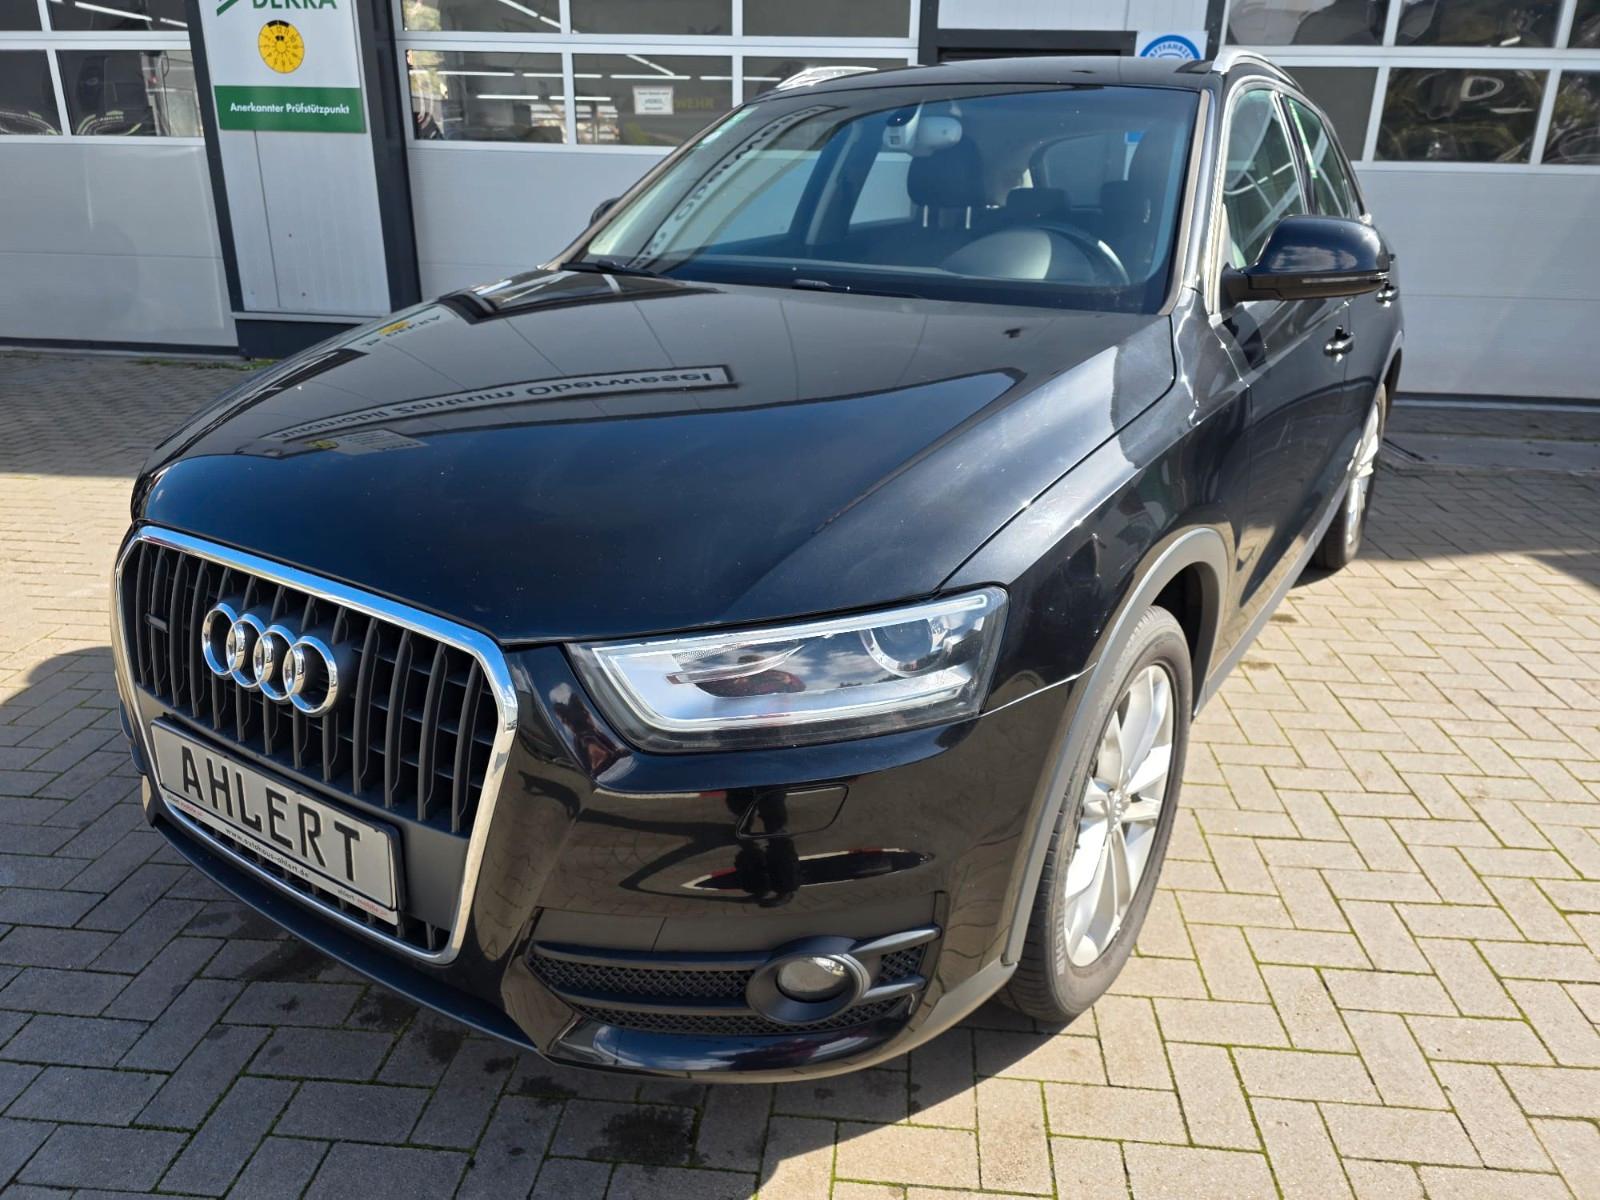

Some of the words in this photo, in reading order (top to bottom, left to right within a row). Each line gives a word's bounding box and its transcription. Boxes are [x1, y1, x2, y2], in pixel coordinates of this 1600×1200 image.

[230, 101, 284, 113] Anerkannter
[285, 102, 350, 116] Prüfstützpunkt
[181, 745, 361, 882] AHLERT
